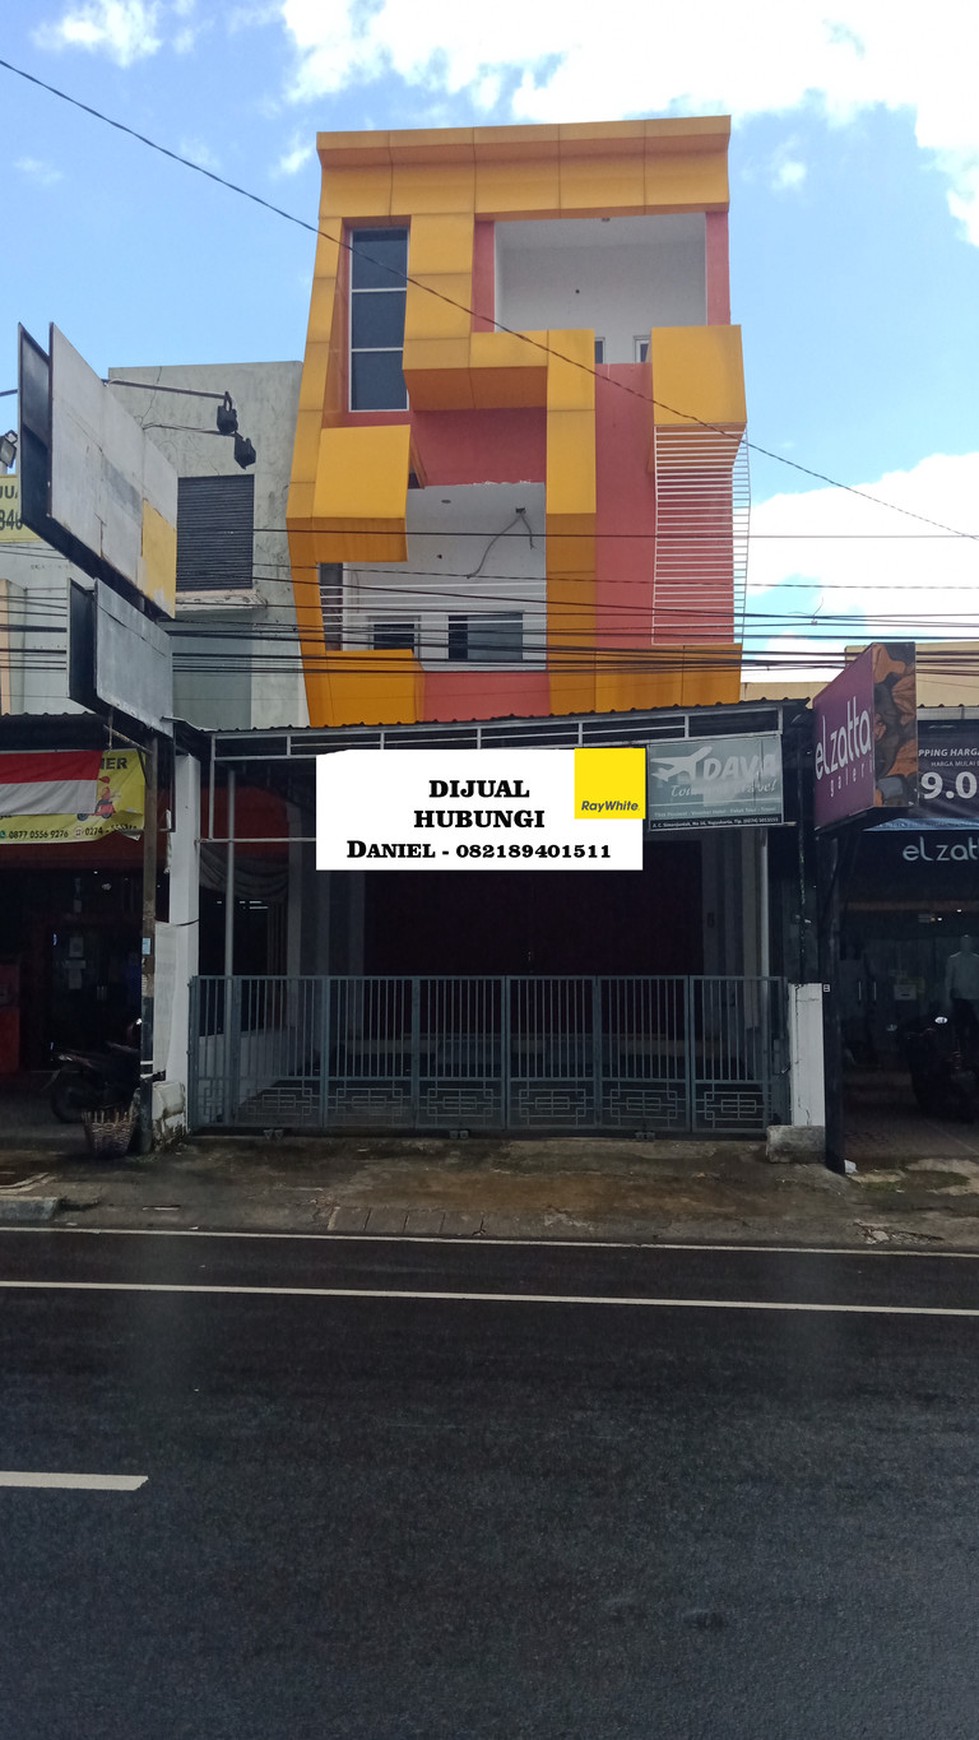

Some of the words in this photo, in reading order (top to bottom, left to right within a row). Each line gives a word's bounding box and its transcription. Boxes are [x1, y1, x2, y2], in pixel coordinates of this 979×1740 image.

[815, 696, 871, 780] elzatta
[949, 748, 979, 757] HARG
[830, 754, 872, 797] galeri
[920, 771, 977, 800] 9.0
[9, 830, 28, 839] 0877
[29, 830, 48, 839] 0556
[50, 829, 69, 838] 9276
[85, 826, 103, 836] 0274
[902, 836, 979, 861] elzat
